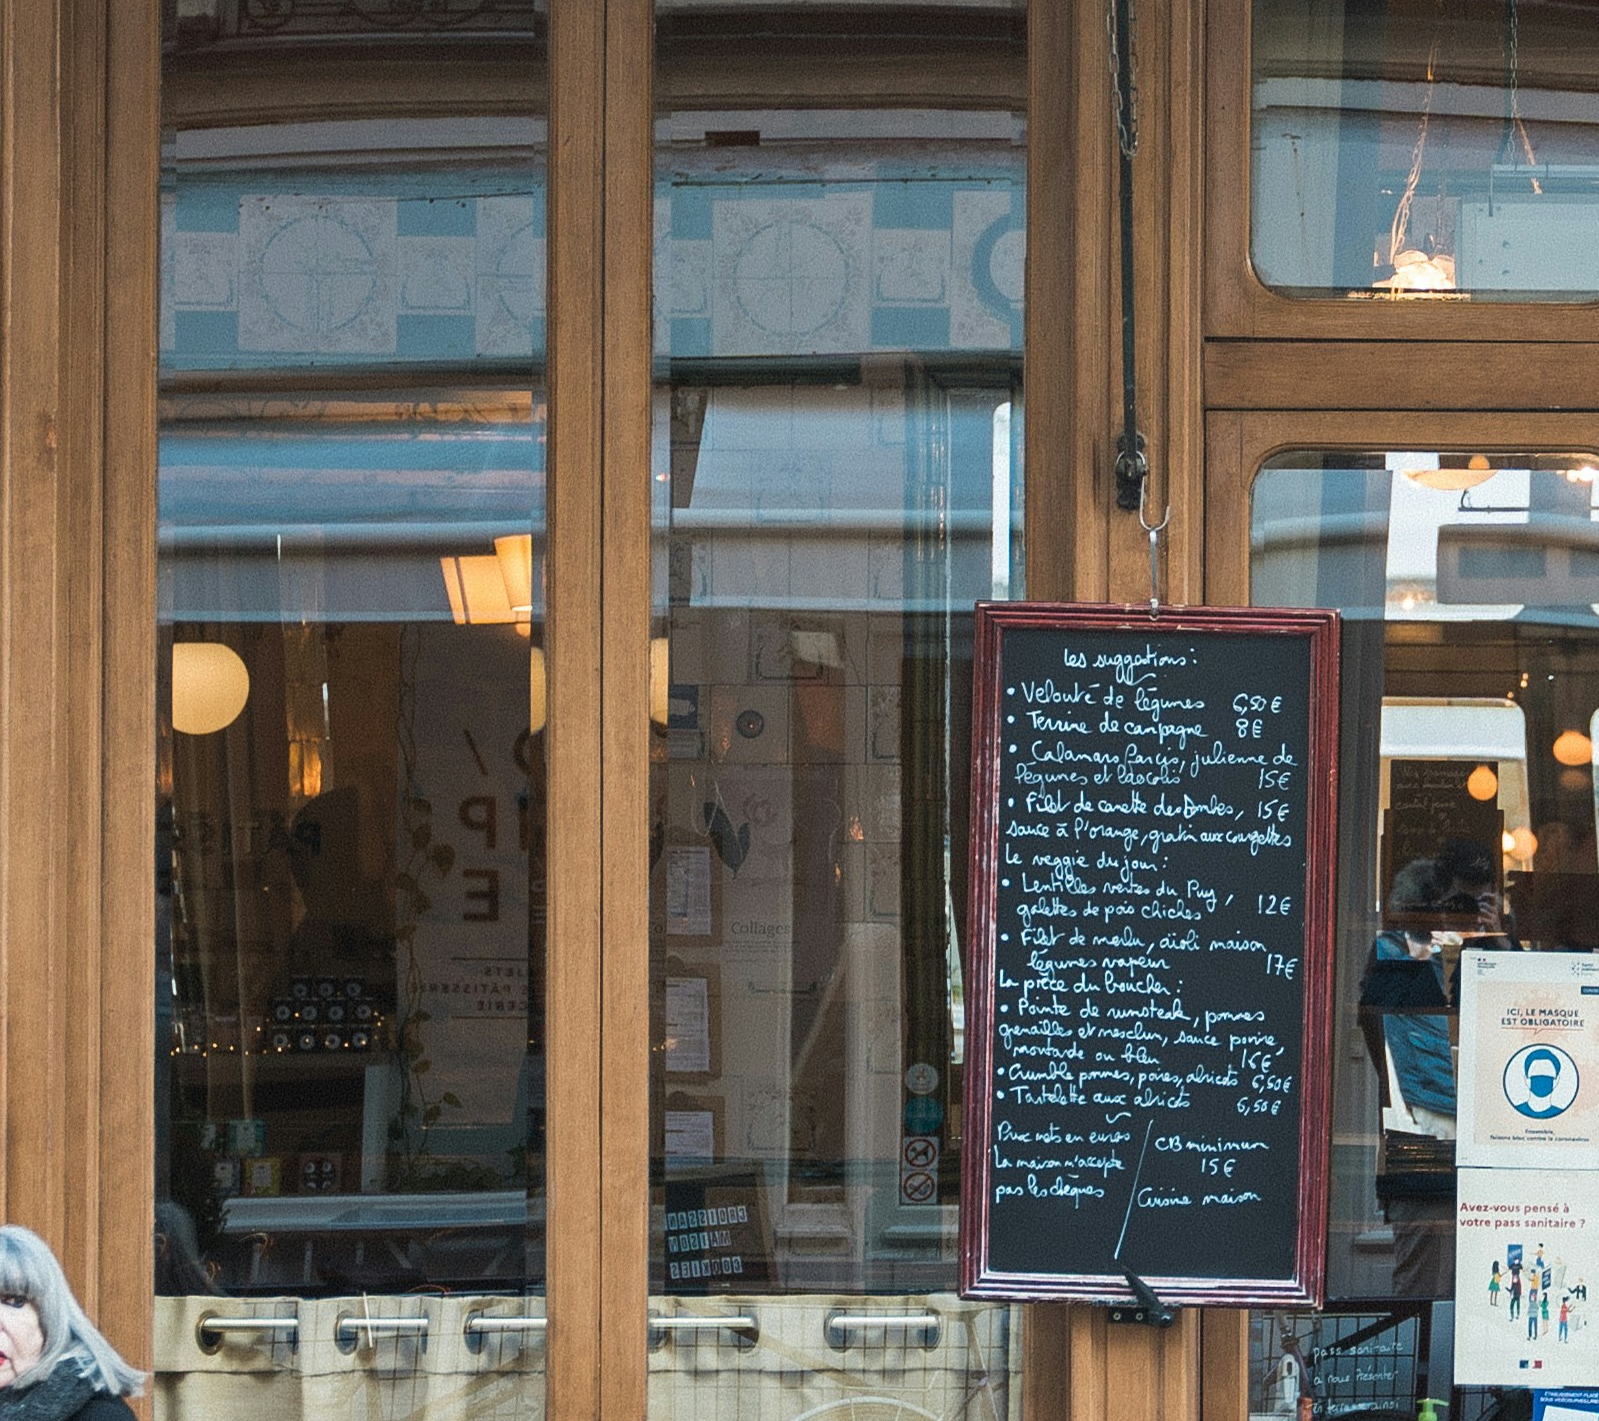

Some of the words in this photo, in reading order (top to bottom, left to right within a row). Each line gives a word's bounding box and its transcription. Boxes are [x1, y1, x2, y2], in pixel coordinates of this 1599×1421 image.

[1103, 686, 1124, 708] de
[1026, 711, 1092, 733] Terrine
[1100, 713, 1120, 733] de
[1273, 744, 1297, 766] de
[1073, 798, 1094, 814] de
[1156, 880, 1178, 896] du
[1083, 900, 1098, 917] de
[1506, 1008, 1522, 1018] ICI,
[1526, 1009, 1535, 1017] LE
[1539, 1008, 1579, 1018] MASQUE
[1501, 1018, 1517, 1026] EST
[1520, 1018, 1584, 1027] OBLIGATOIRE
[1460, 1203, 1520, 1212] Avez-vous
[1524, 1203, 1559, 1215] pensé
[1564, 1203, 1569, 1213] à
[1460, 1218, 1490, 1227] votre
[1495, 1220, 1520, 1229] pass
[1525, 1218, 1576, 1228] sanitaire
[1580, 1219, 1585, 1228] ?
